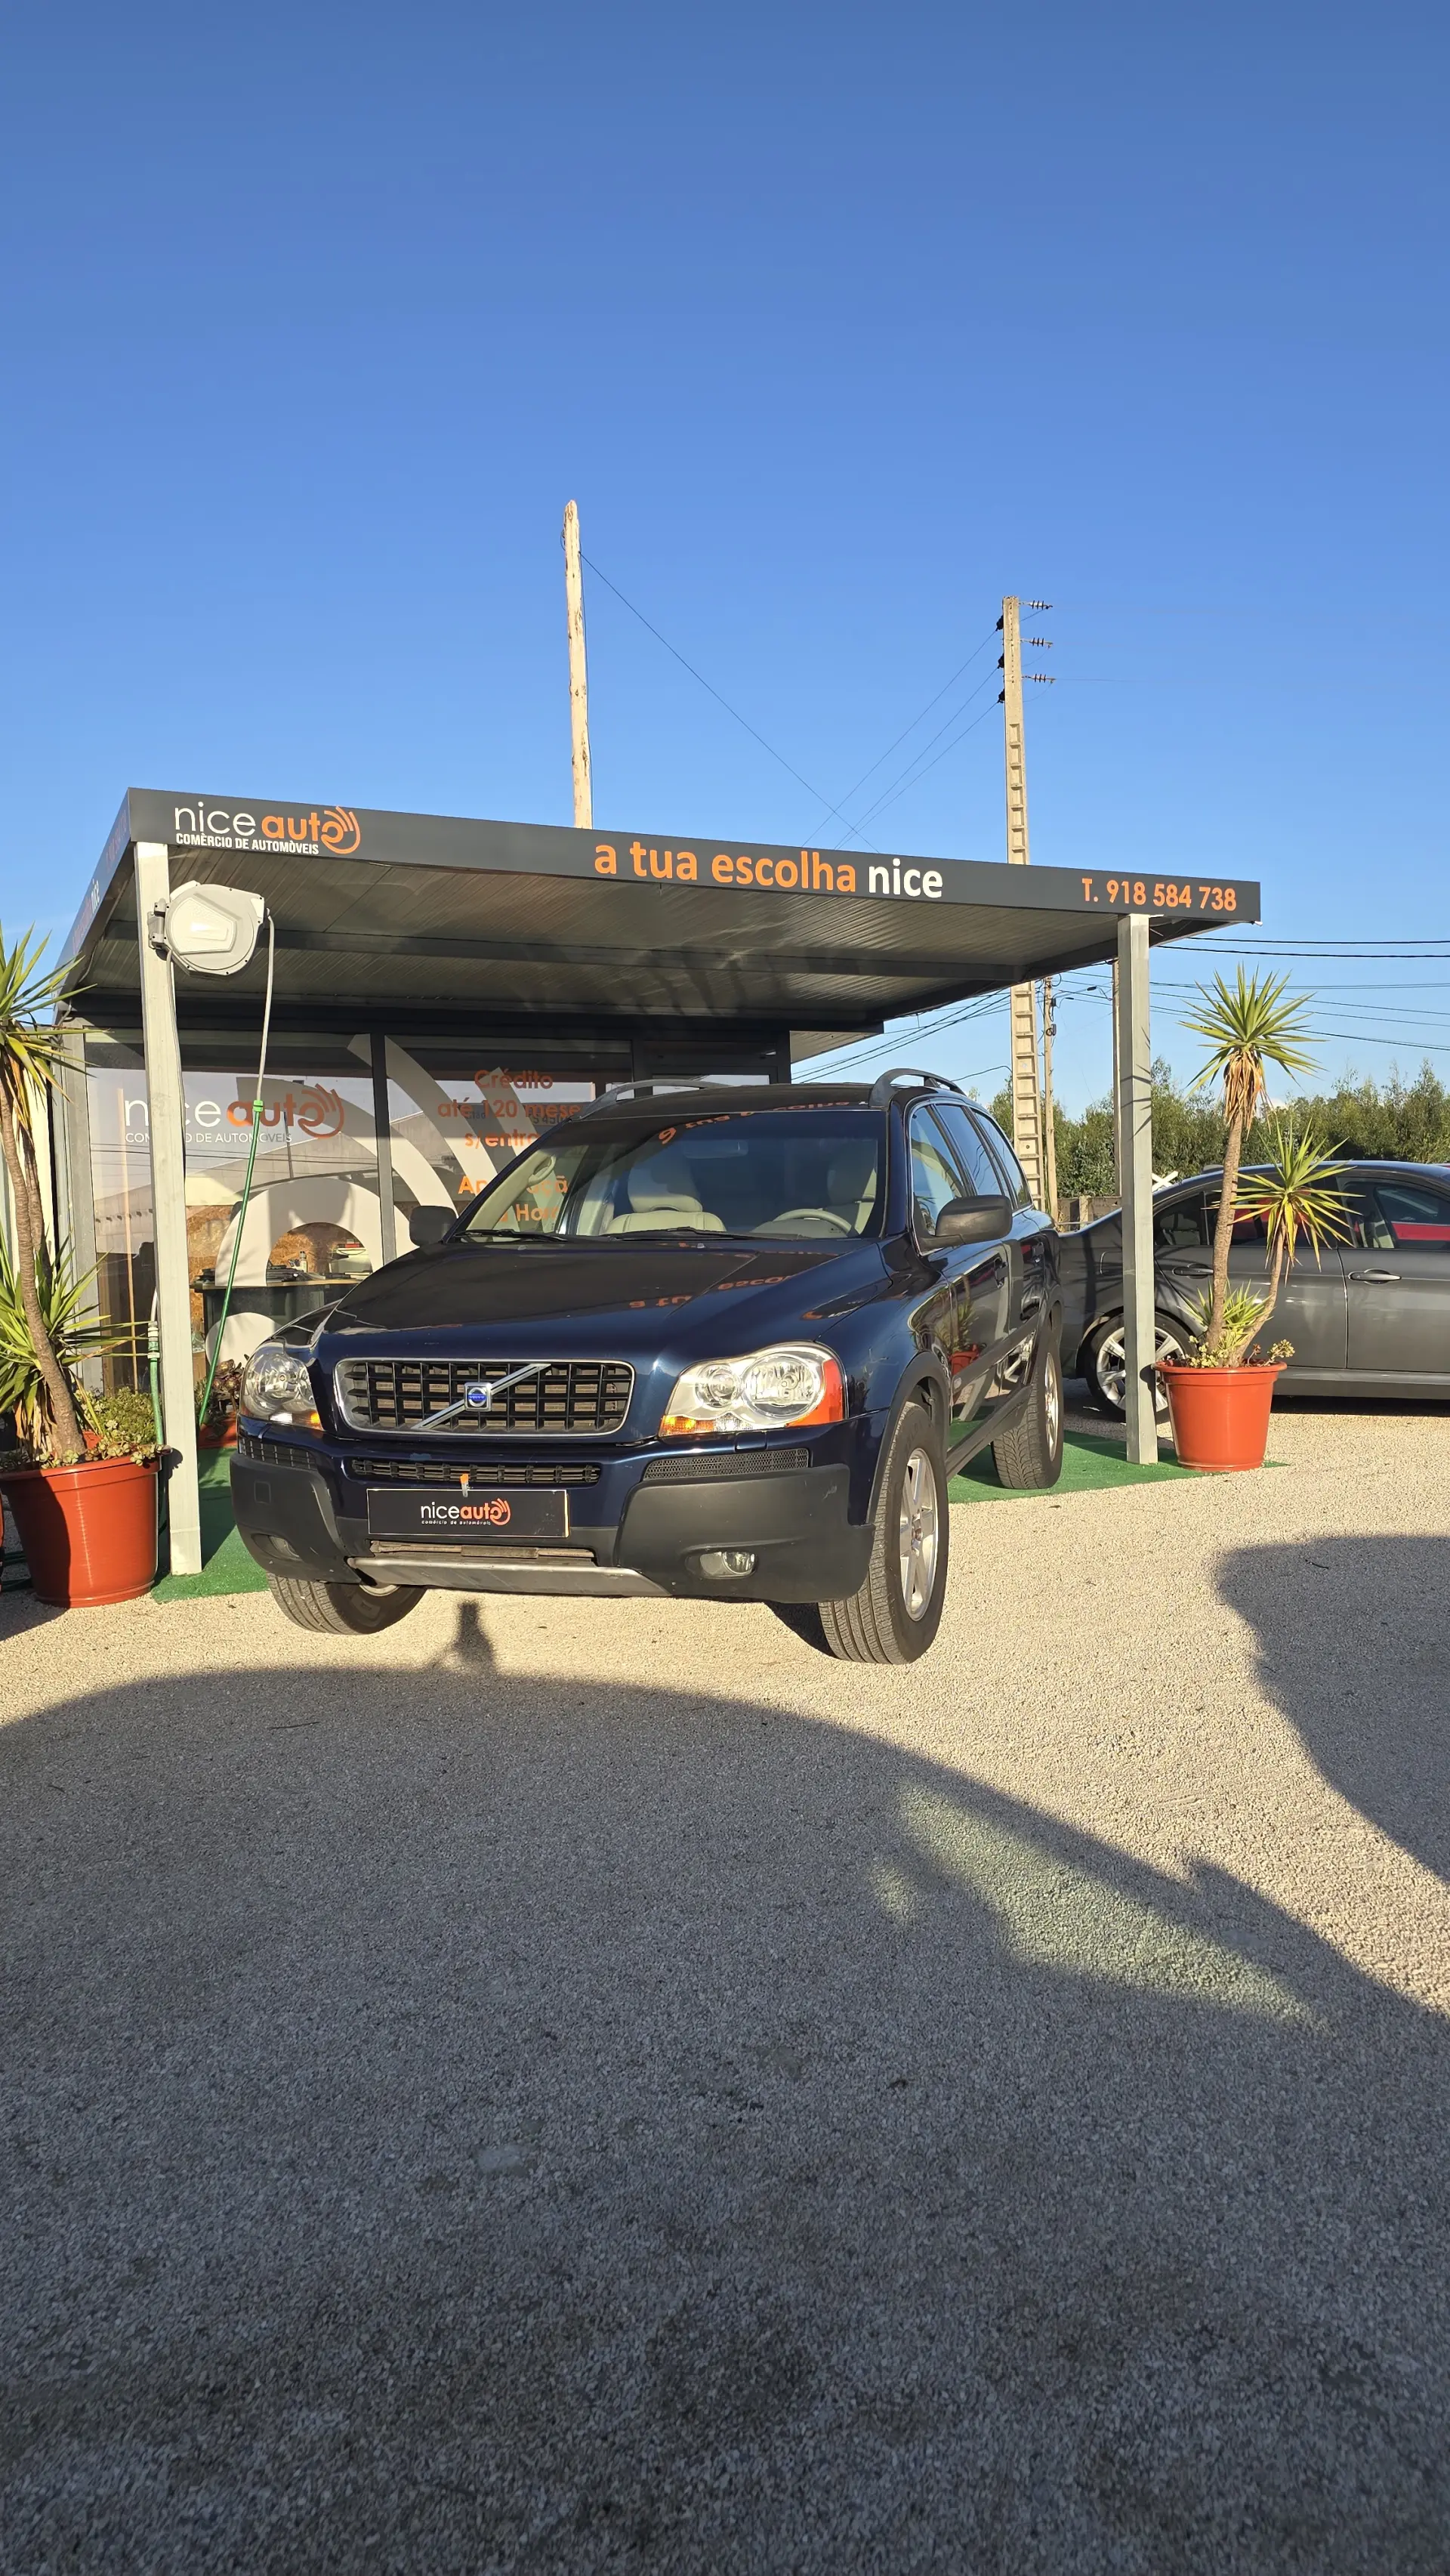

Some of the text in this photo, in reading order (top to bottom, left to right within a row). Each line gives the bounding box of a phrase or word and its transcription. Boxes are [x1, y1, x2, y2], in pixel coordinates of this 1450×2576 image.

[235, 839, 249, 849] DE
[594, 841, 943, 898] a tua escolha nice
[1081, 878, 1237, 911] T. 918 584 738
[474, 1067, 553, 1089] Crédito
[437, 1097, 472, 1118] até
[481, 1099, 518, 1118] 120
[526, 1104, 582, 1118] mese
[196, 1133, 211, 1143] DE
